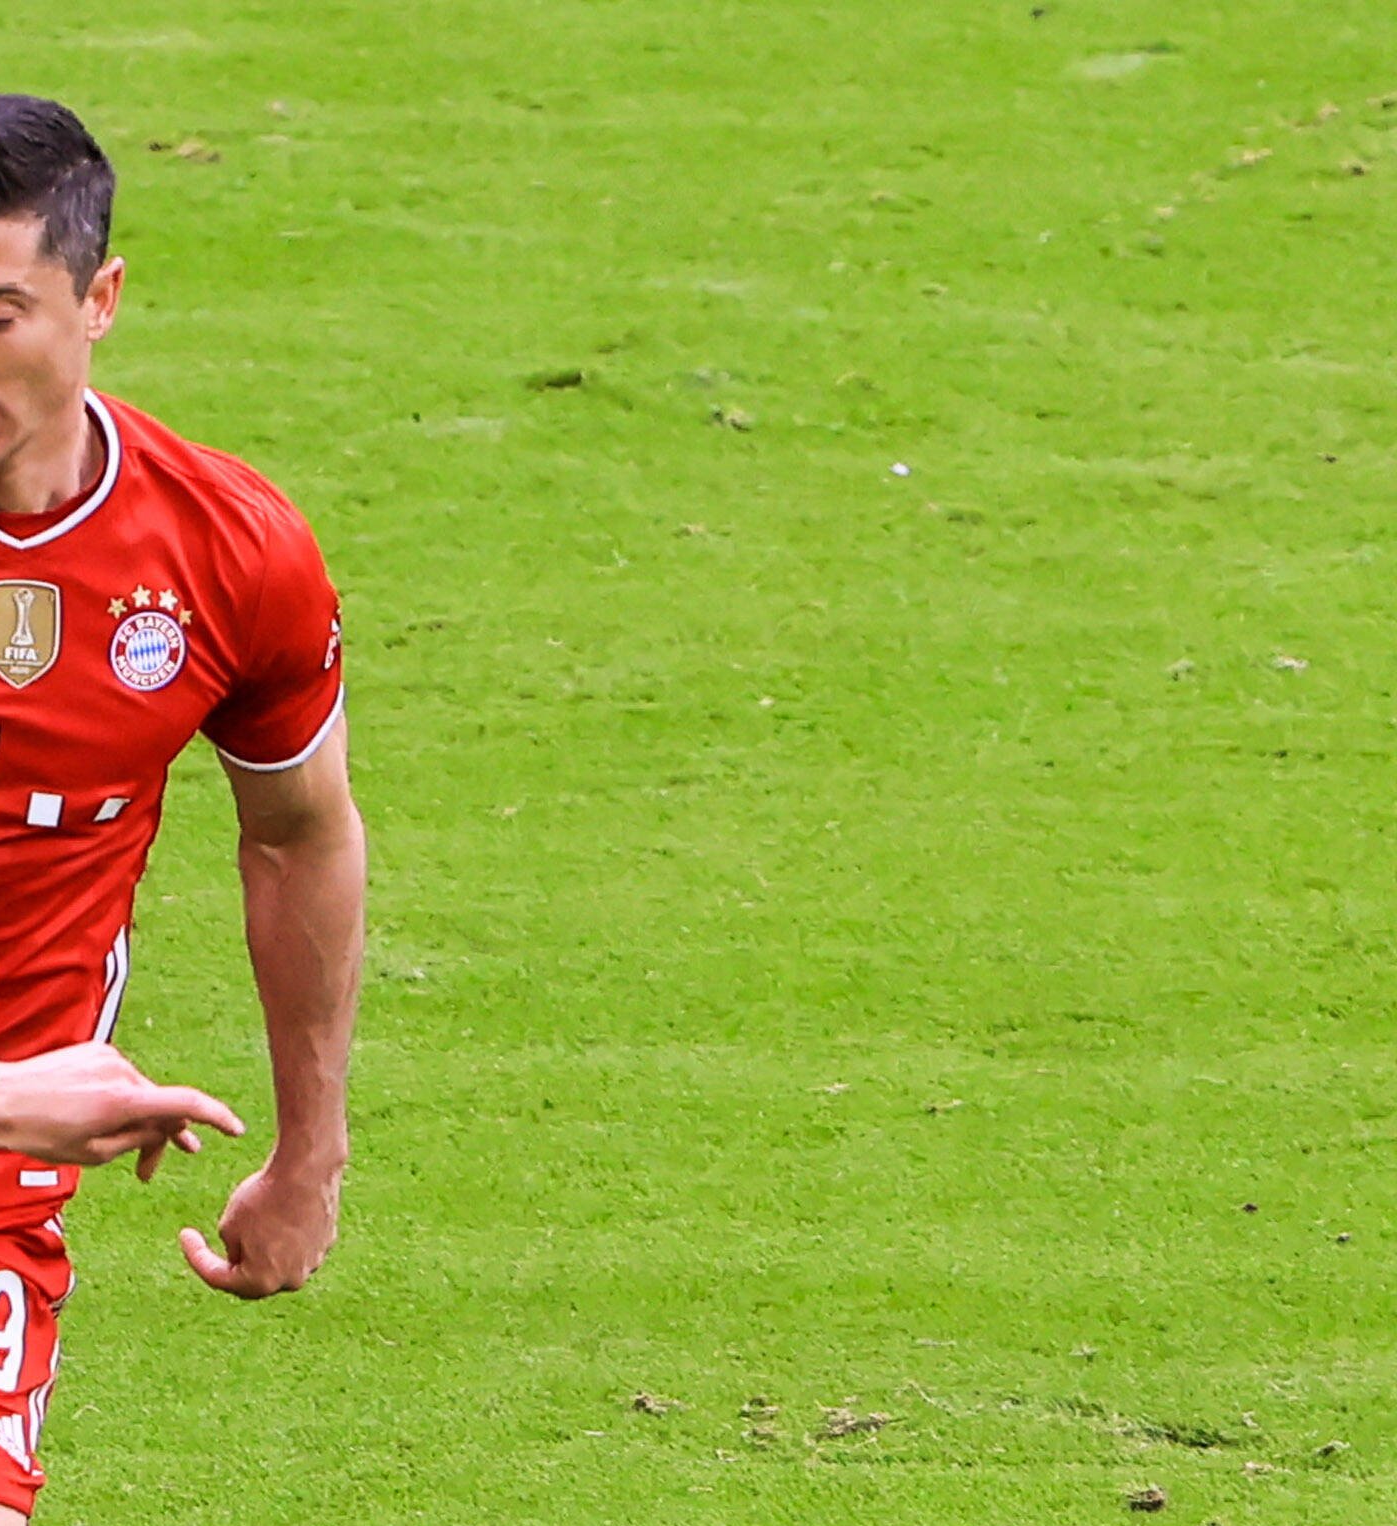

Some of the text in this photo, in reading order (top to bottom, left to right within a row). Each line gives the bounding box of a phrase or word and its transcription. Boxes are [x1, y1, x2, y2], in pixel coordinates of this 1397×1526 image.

[117, 616, 180, 649] FC BAYERN
[4, 646, 38, 661] FIFA
